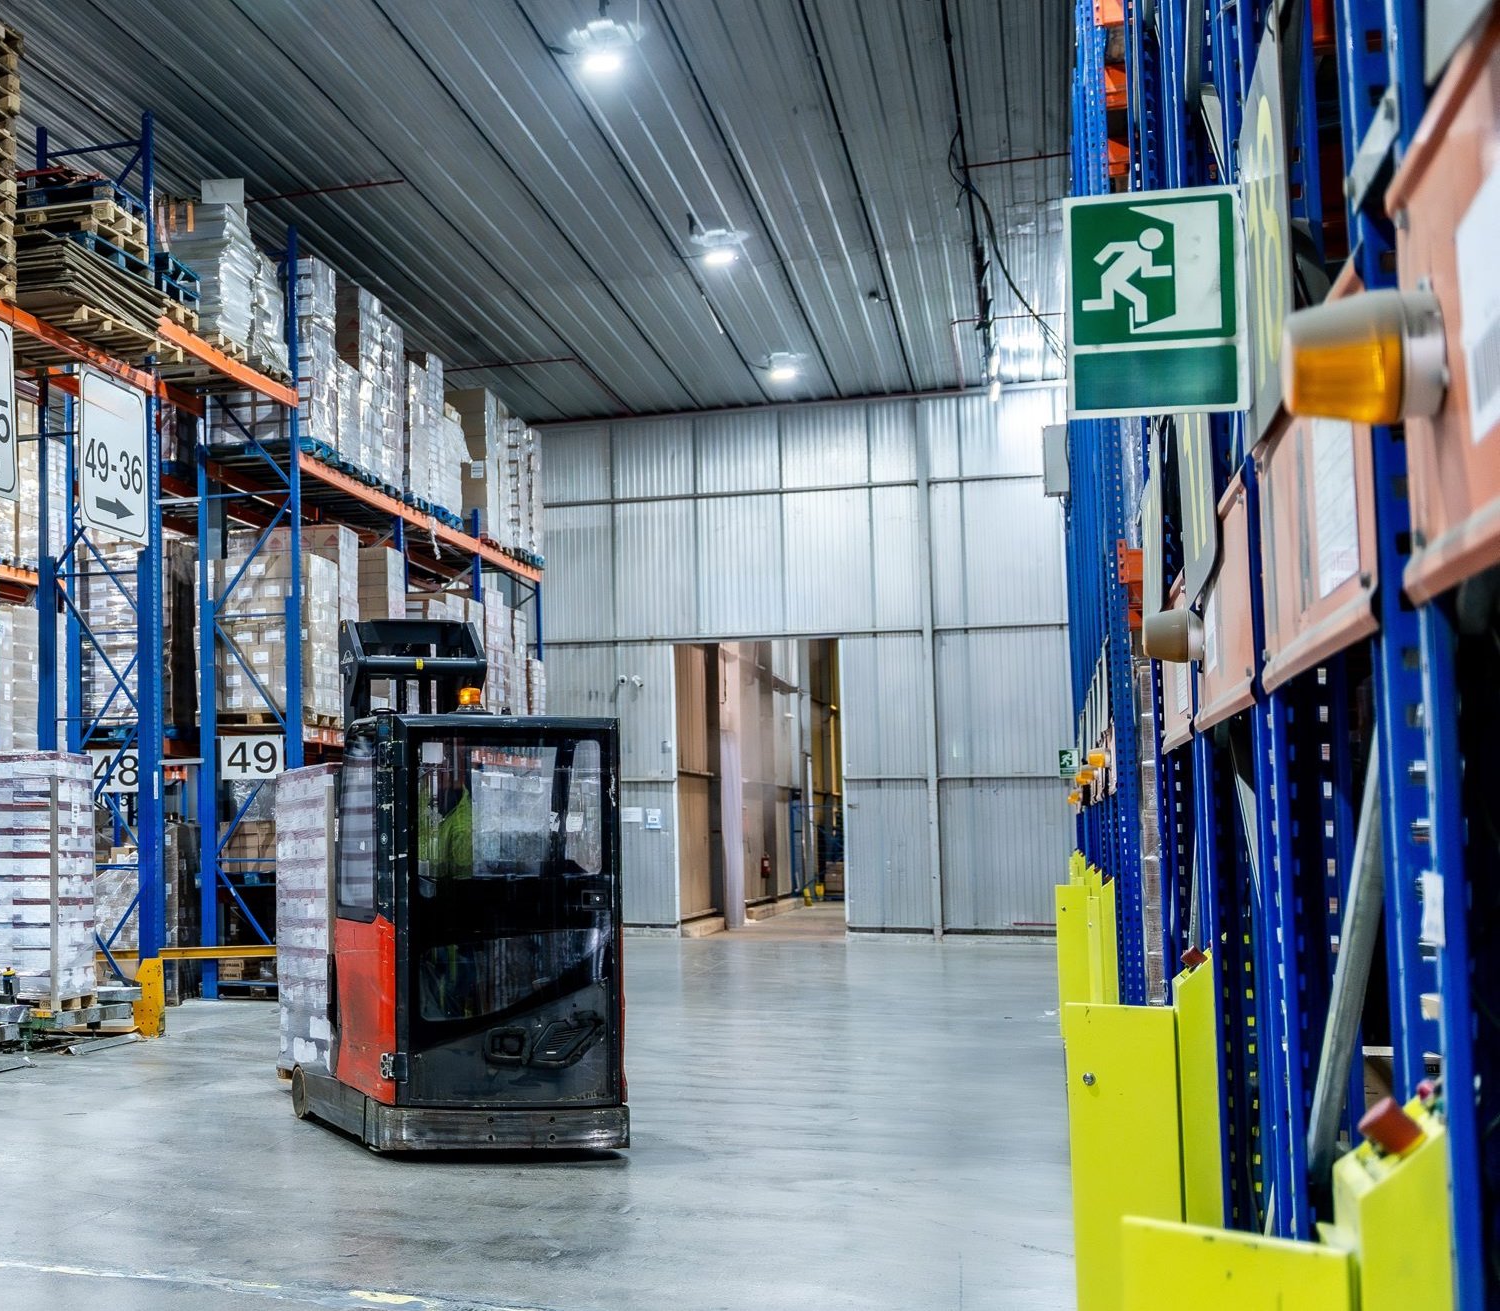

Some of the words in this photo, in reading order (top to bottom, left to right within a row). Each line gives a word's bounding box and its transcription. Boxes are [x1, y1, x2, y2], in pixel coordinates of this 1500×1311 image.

[85, 438, 143, 495] 49-36
[94, 755, 138, 787] 48
[227, 741, 277, 774] 49
